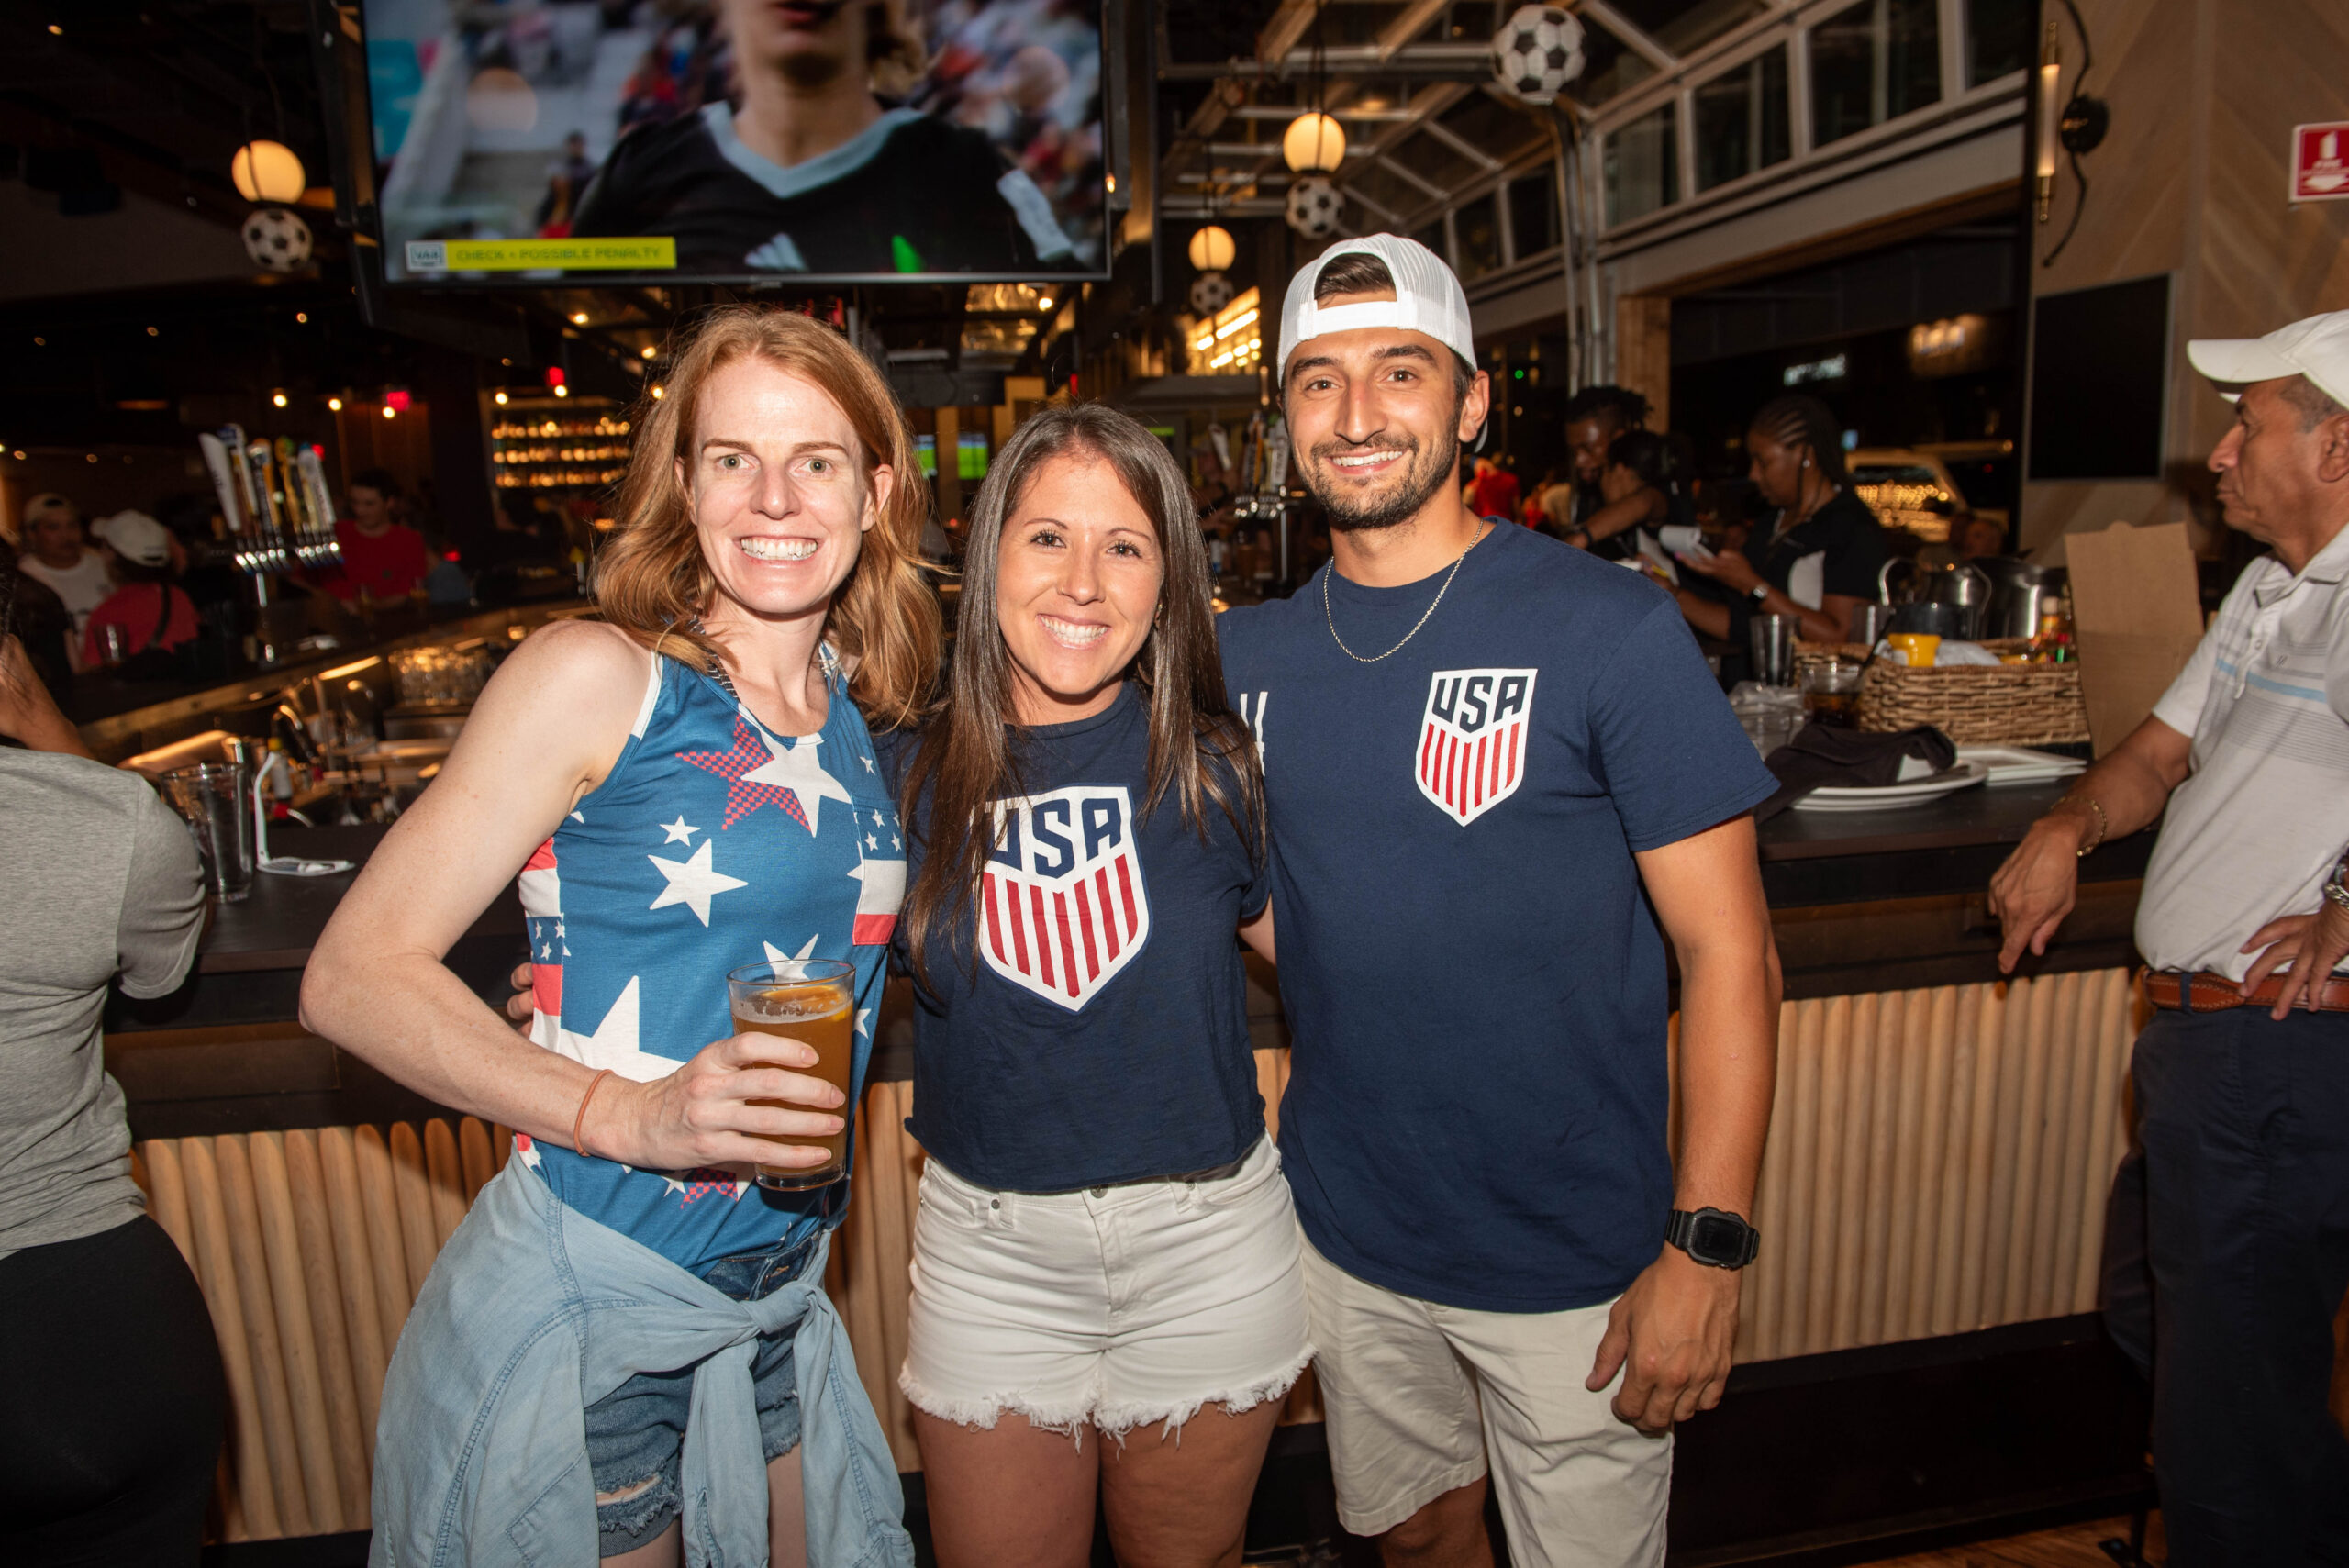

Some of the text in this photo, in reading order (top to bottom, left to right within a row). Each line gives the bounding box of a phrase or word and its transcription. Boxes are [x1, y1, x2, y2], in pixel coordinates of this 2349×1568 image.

[456, 248, 505, 261] CHECK
[518, 246, 592, 260] POSSIBLE
[595, 246, 662, 259] PENALTY
[1432, 675, 1529, 734] USA
[981, 798, 1122, 880] USA
